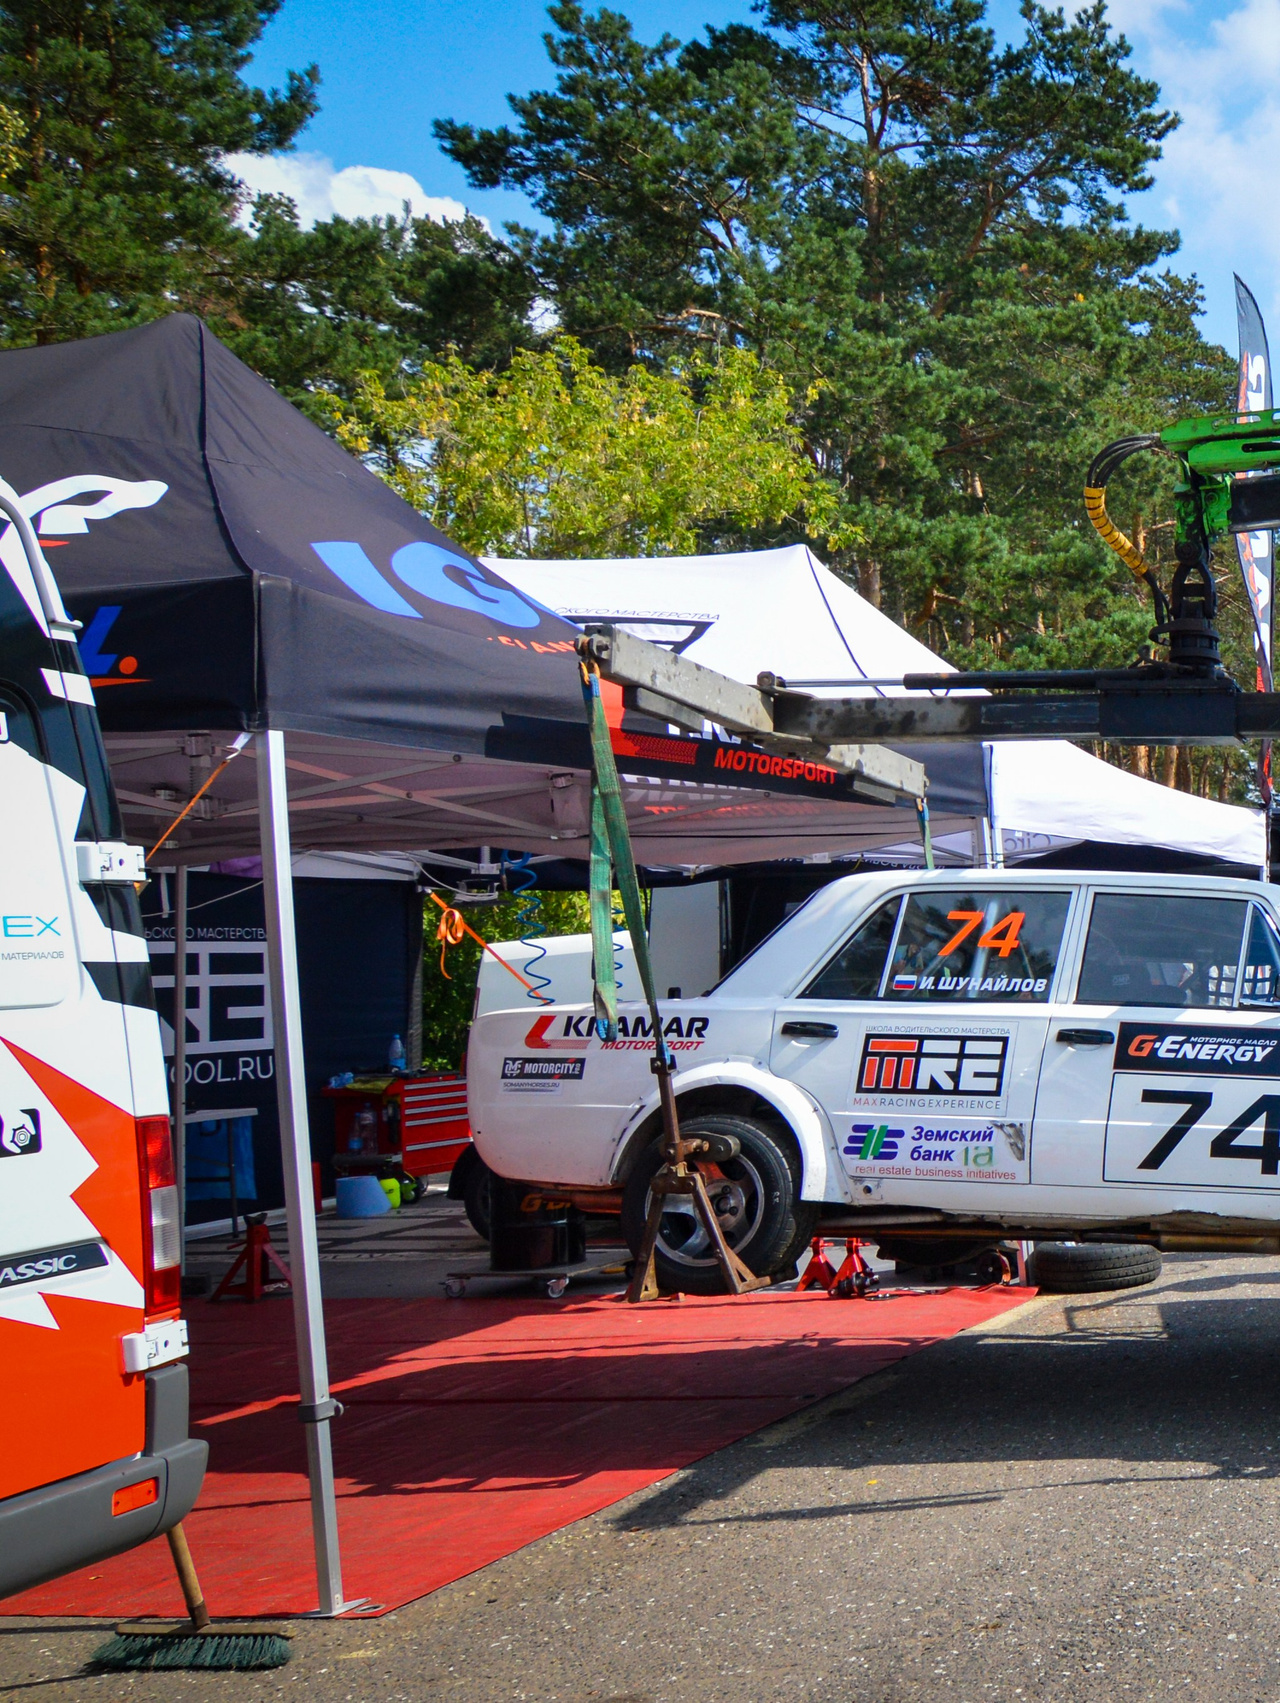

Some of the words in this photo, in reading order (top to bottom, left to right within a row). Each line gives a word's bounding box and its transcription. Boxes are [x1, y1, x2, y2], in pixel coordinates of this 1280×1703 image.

[612, 608, 720, 620] МАСТЕРСТВА
[714, 747, 838, 785] MOTORSPORT
[197, 927, 267, 939] МАСТЕРСТВ
[937, 910, 1026, 958] 74
[1, 951, 65, 961] МАТЕРИАЛОВ
[1190, 1036, 1242, 1045] МОТОРНОЕ
[164, 1055, 274, 1085] OOL.RU
[911, 1125, 994, 1142] Земский
[910, 1145, 956, 1162] банк
[855, 1165, 876, 1174] real
[879, 1166, 912, 1176] estate
[915, 1166, 963, 1178] business
[966, 1168, 1016, 1180] initiatives
